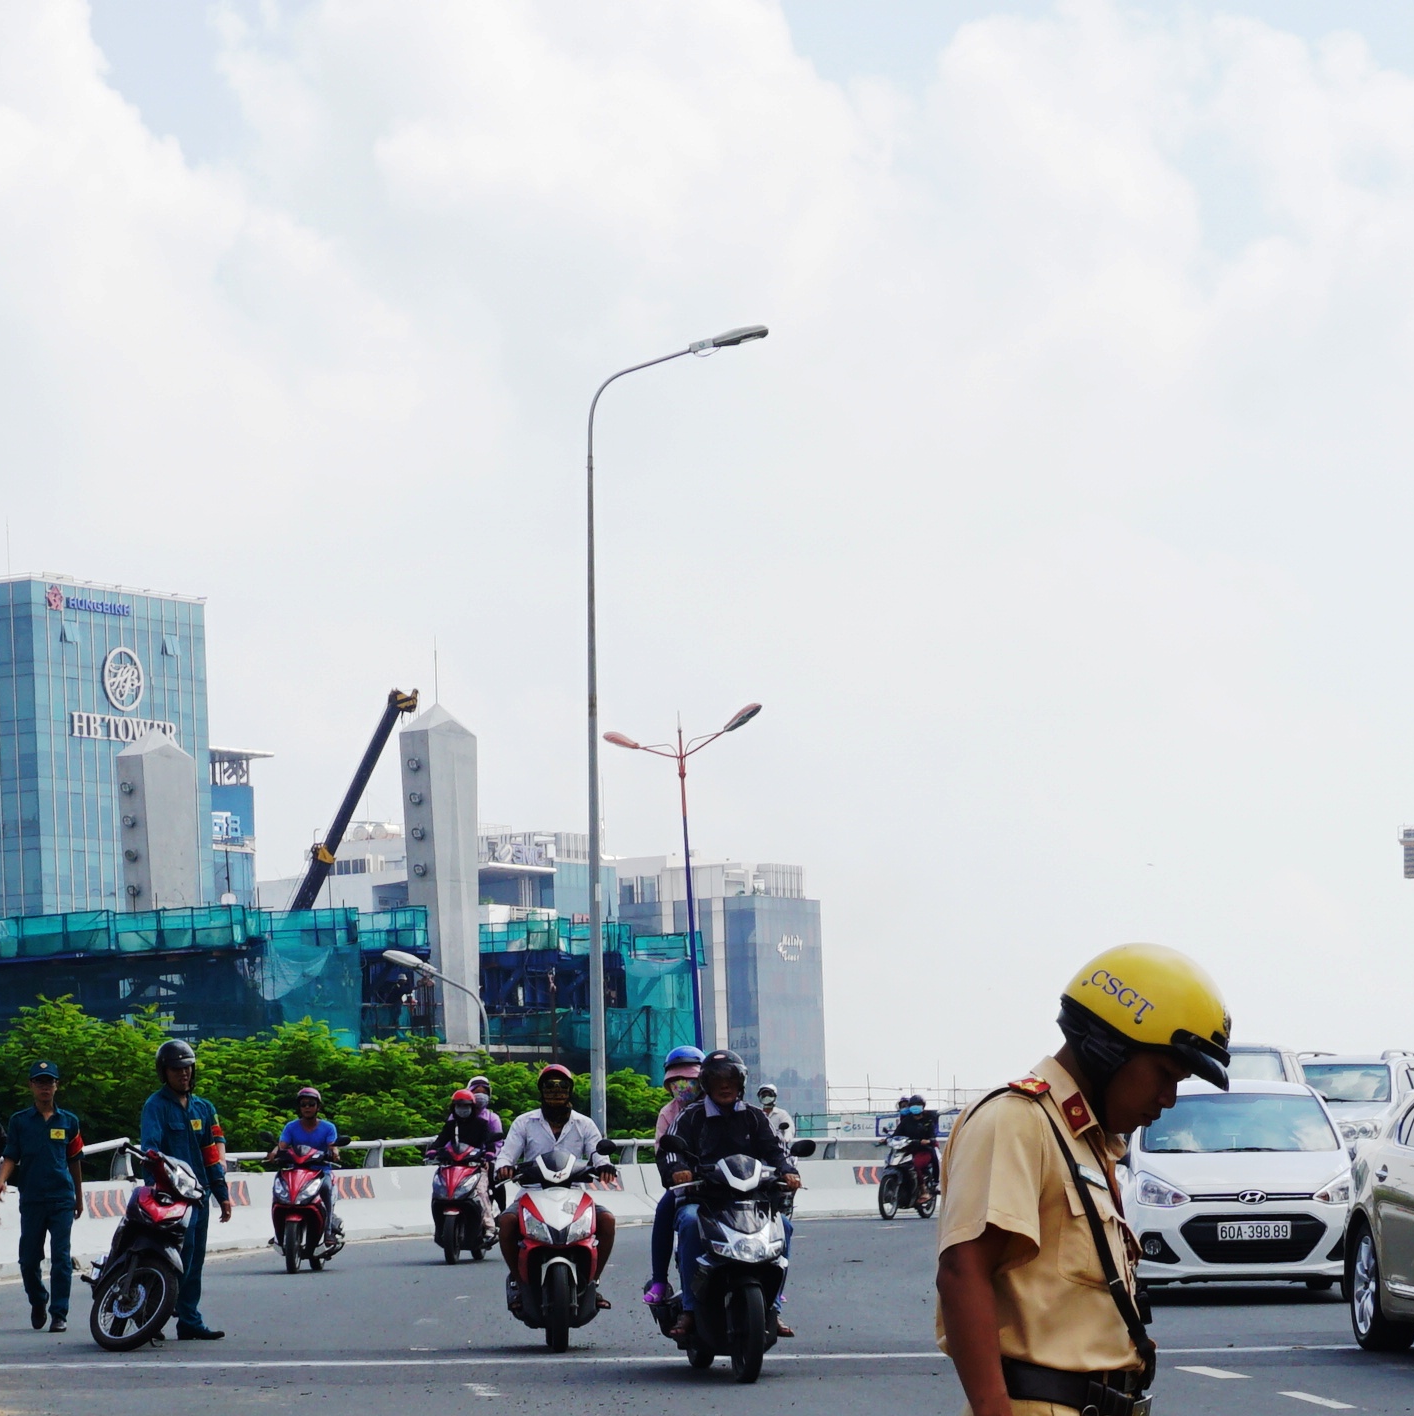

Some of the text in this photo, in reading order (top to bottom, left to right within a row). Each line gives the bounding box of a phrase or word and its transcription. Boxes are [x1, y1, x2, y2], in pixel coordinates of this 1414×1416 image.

[70, 711, 102, 738] HB
[1091, 969, 1155, 1017] CSGT
[1220, 1225, 1289, 1239] 60A-398.89
